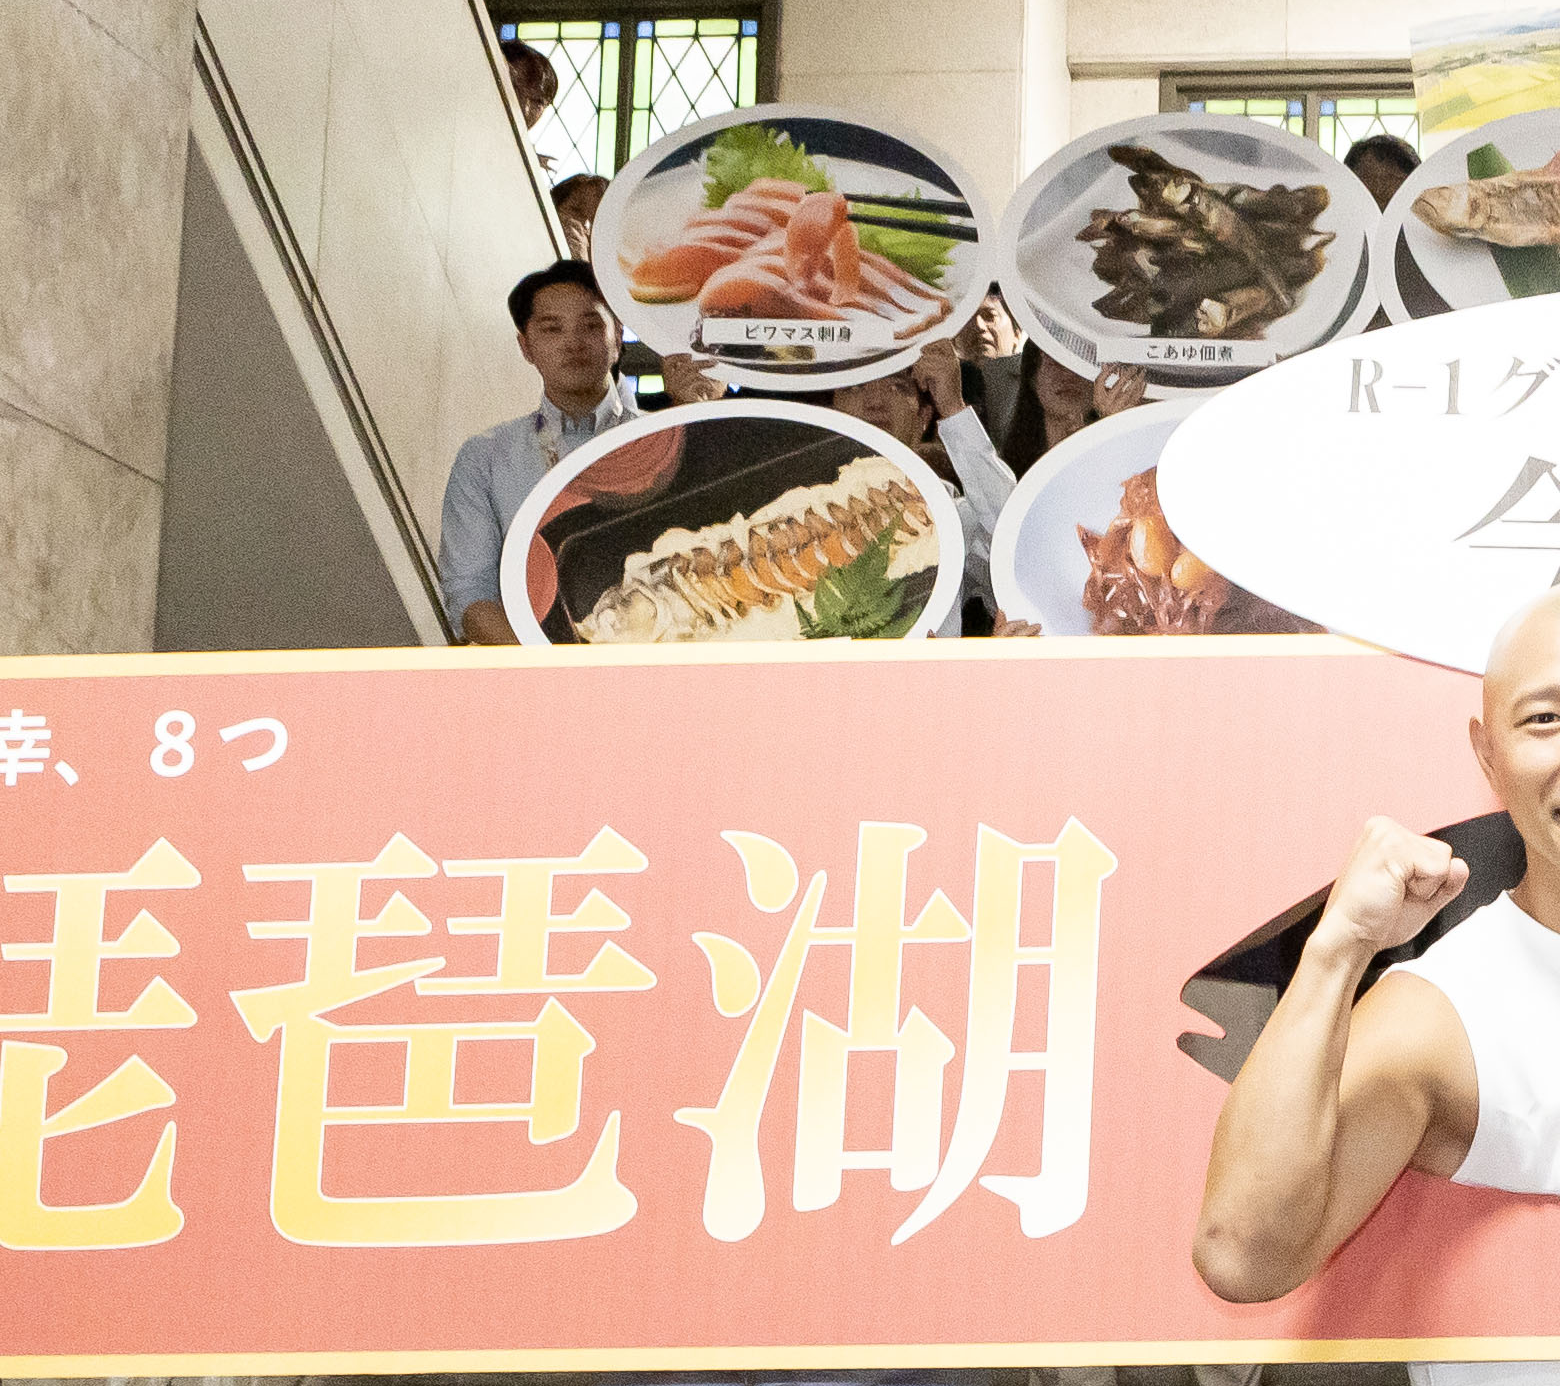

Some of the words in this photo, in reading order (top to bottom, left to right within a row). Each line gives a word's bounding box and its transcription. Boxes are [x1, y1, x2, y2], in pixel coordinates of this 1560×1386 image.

[745, 324, 853, 343] ビワマス刺身
[1146, 345, 1234, 362] こあゆ佃煮
